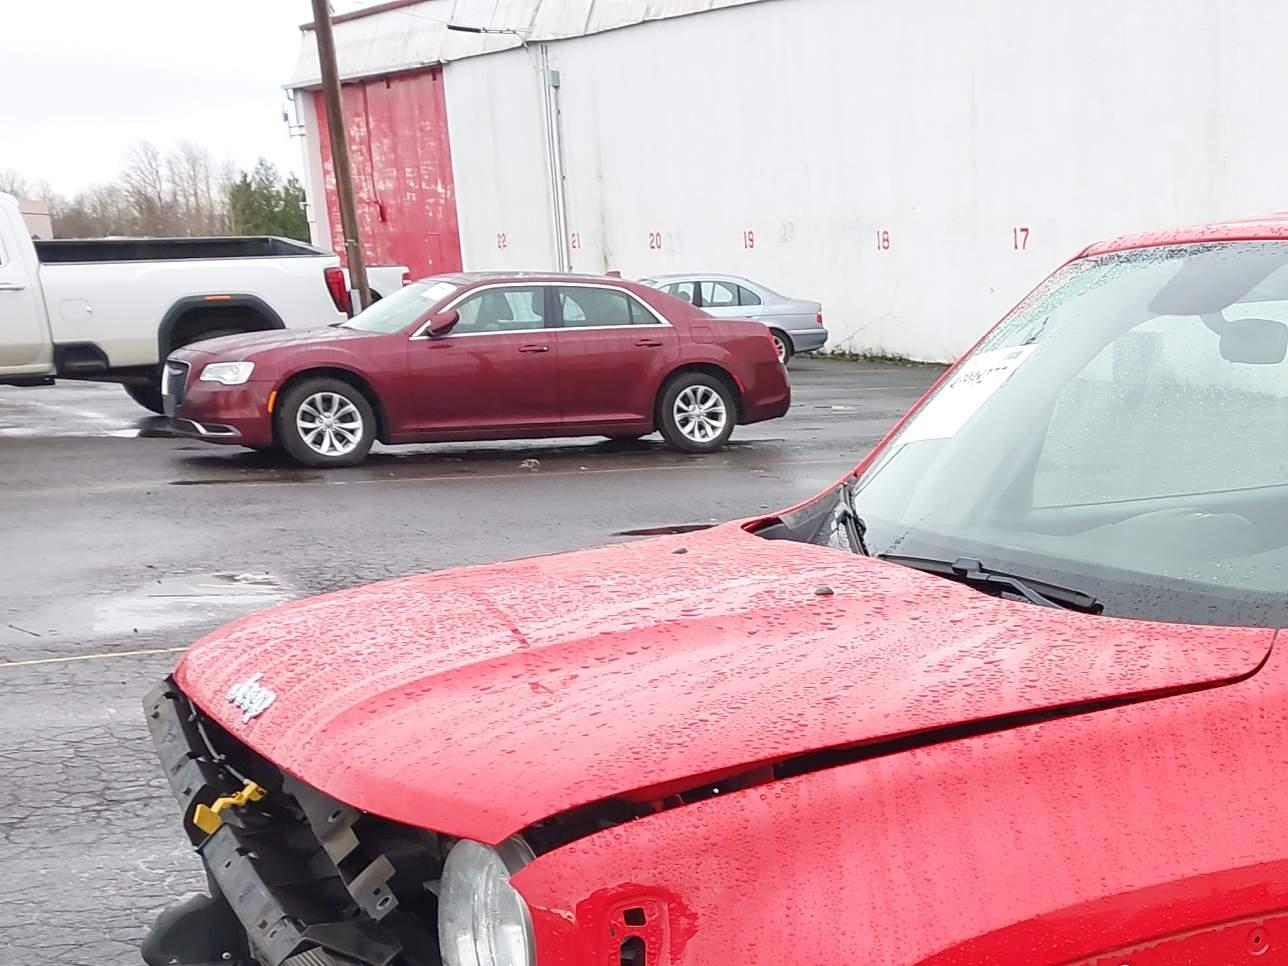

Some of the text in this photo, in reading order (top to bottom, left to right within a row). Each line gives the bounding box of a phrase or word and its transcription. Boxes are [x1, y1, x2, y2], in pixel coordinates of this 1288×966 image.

[648, 231, 662, 249] 20
[743, 230, 755, 249] 19
[876, 230, 890, 251] 18
[1012, 227, 1029, 250] 17
